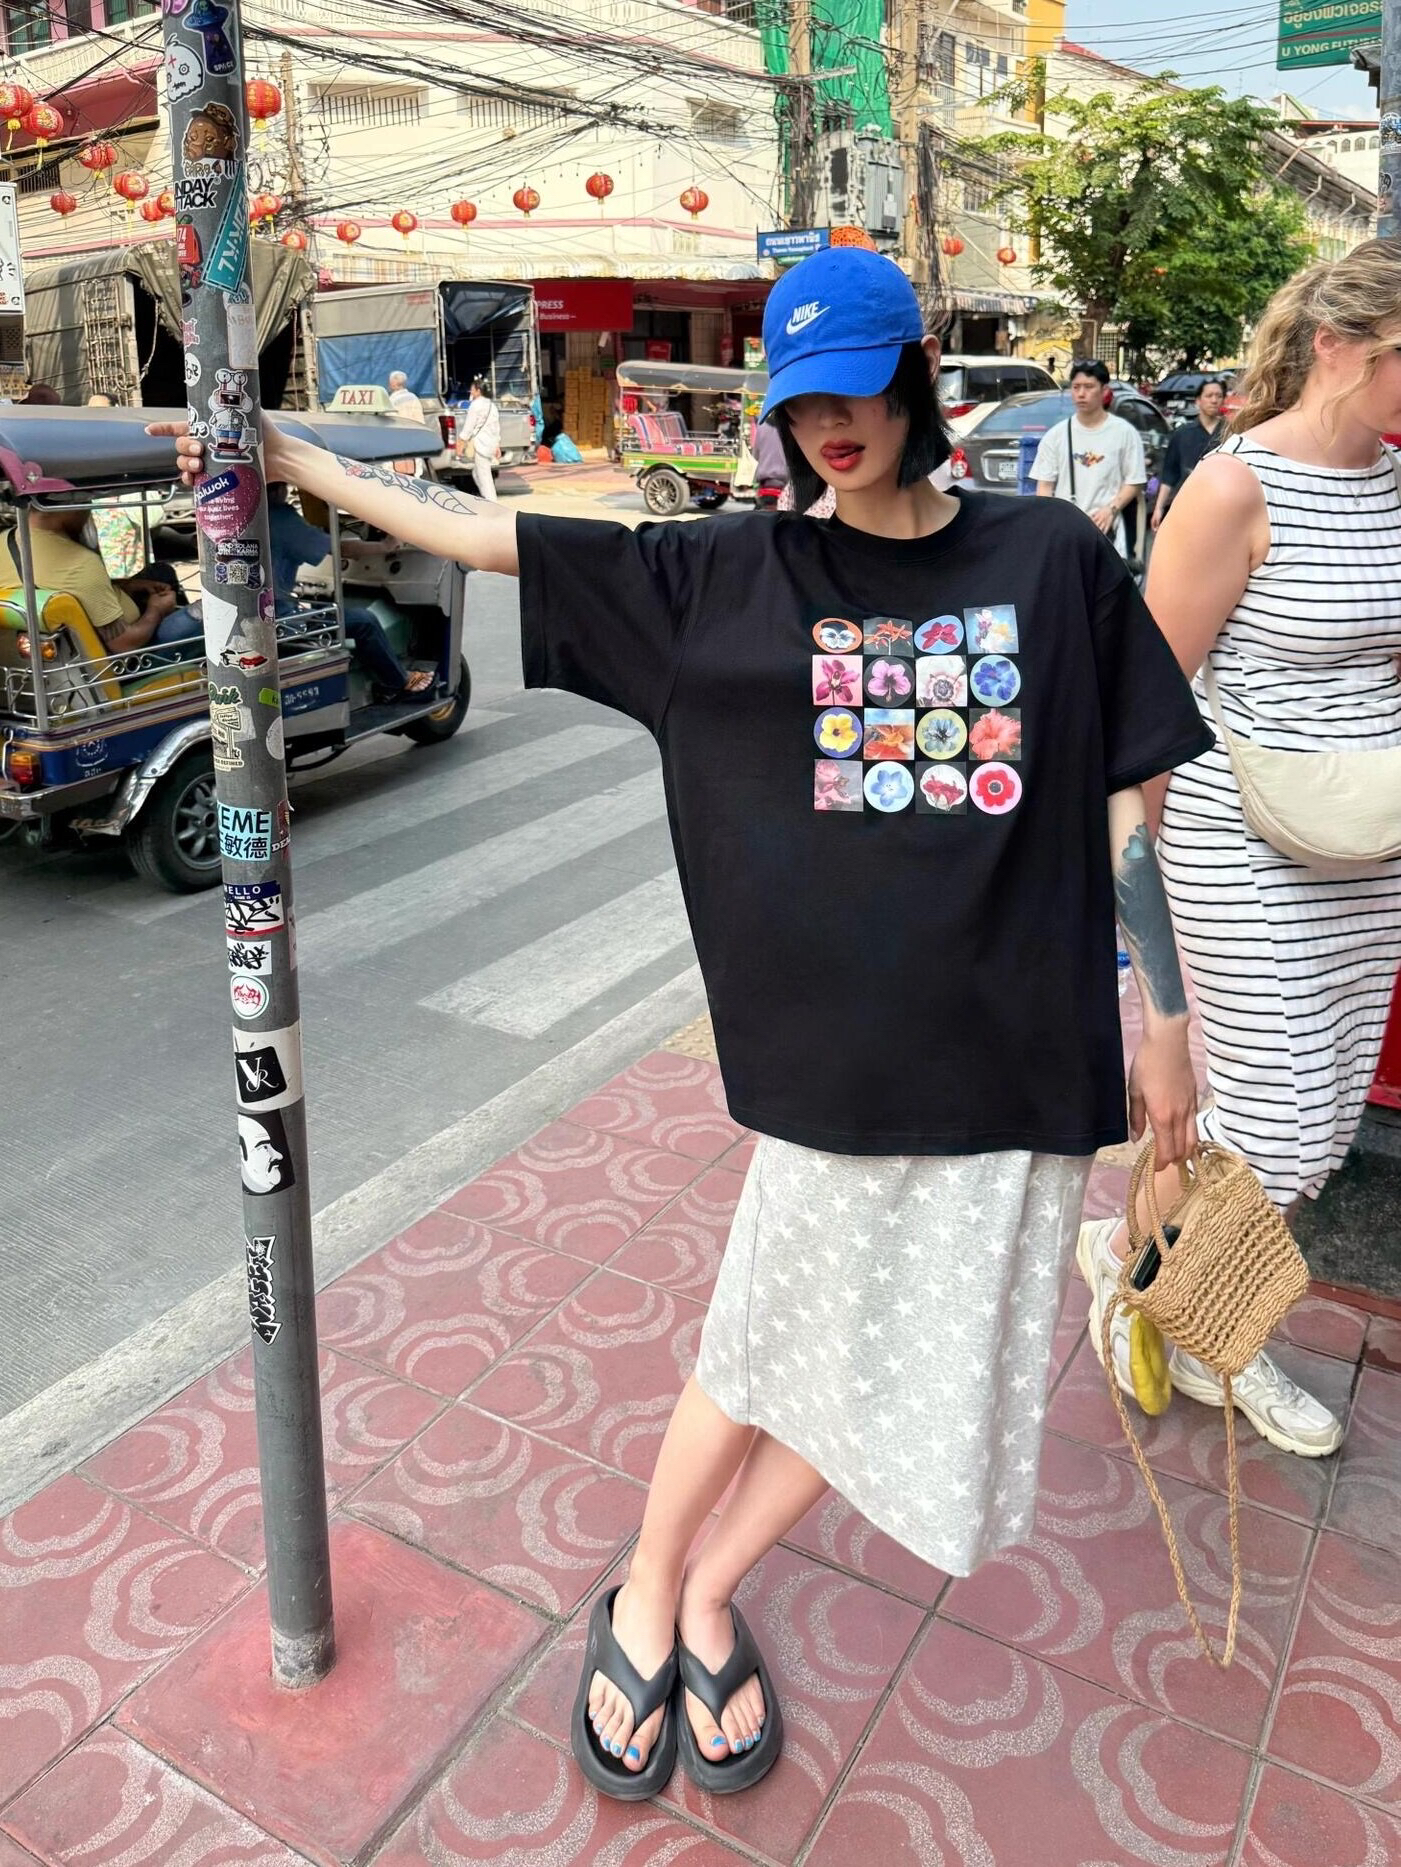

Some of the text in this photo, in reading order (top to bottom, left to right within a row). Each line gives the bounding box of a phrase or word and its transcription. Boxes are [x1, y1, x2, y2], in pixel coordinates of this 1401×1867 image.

[1293, 42, 1329, 56] YONG
[213, 61, 234, 72] SPACE
[792, 301, 820, 323] NIKE
[340, 390, 375, 405] TAXI
[219, 806, 270, 834] EME
